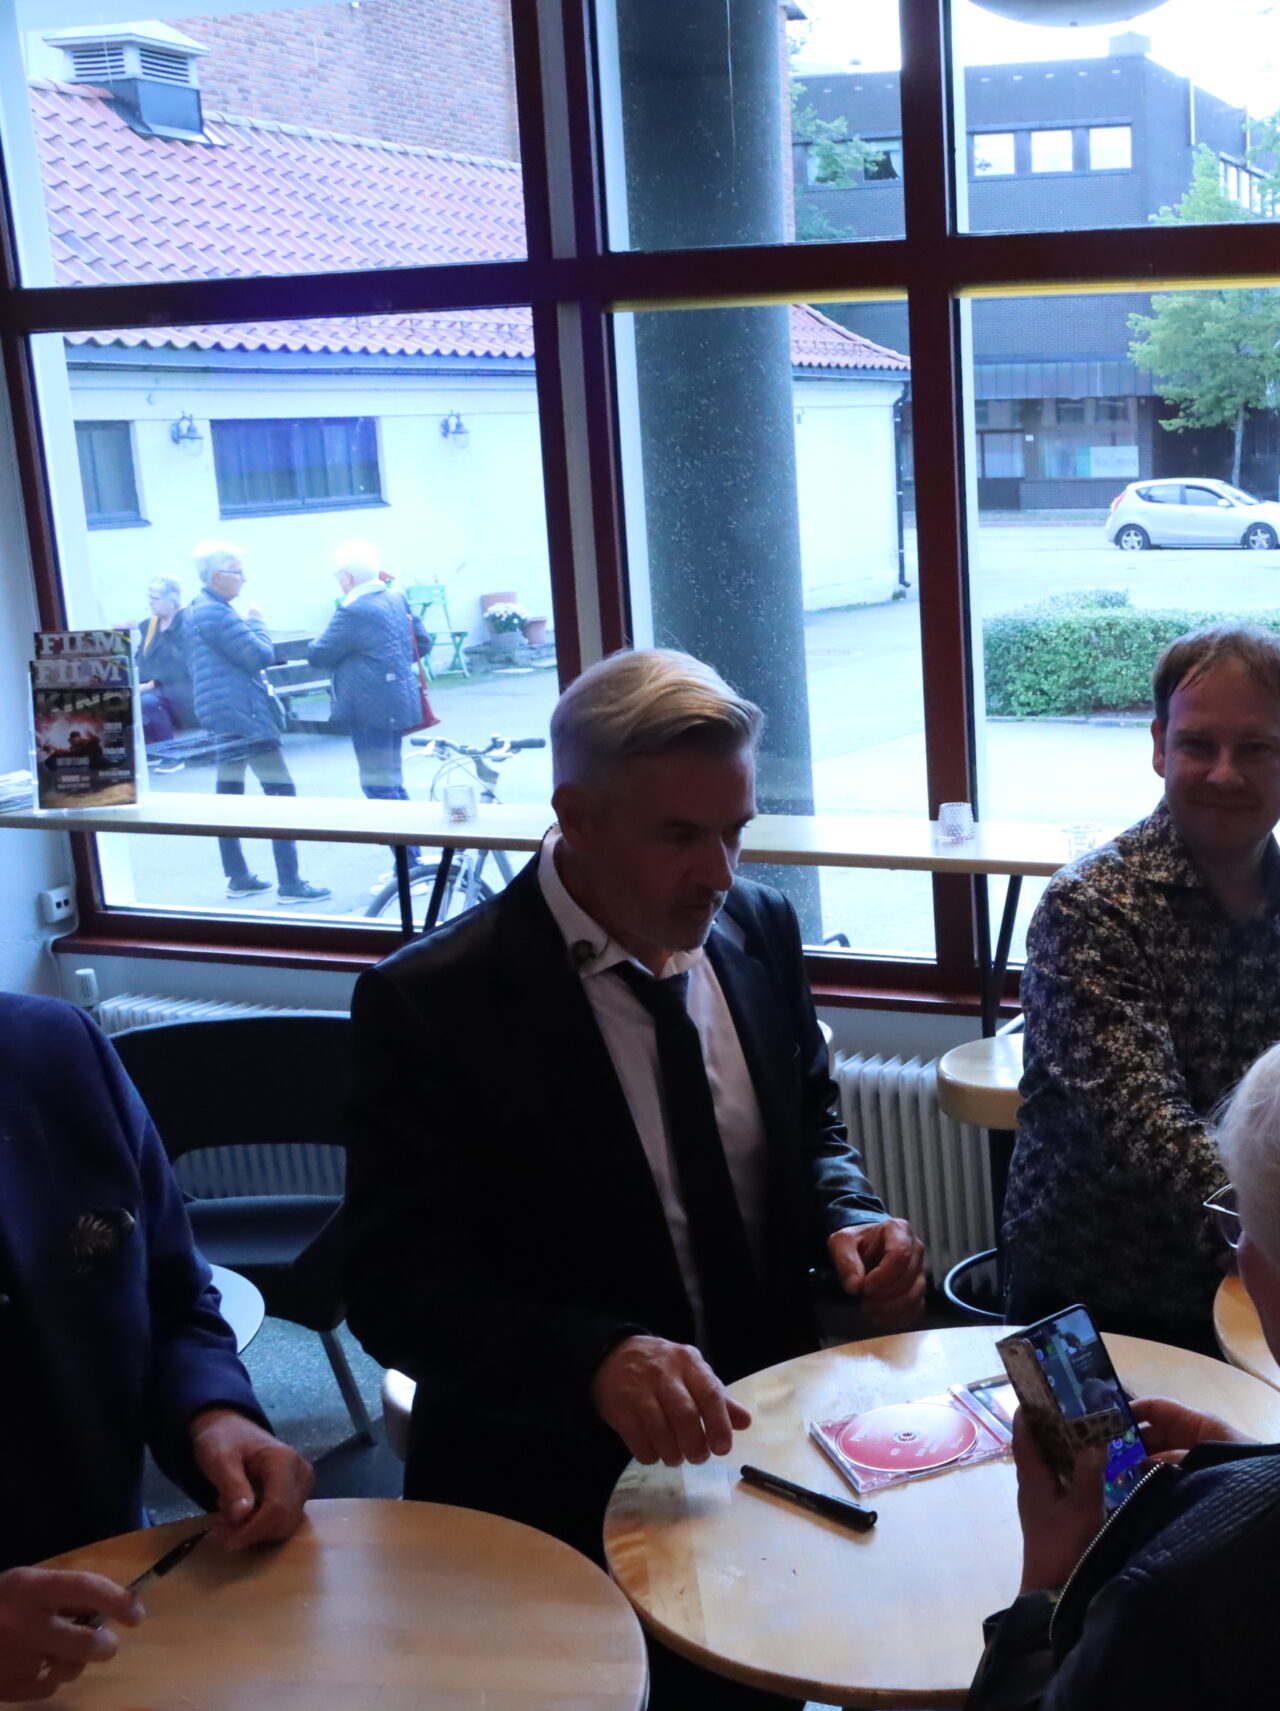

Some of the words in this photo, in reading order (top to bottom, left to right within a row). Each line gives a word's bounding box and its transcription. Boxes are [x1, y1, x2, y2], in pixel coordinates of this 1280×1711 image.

[40, 632, 126, 655] FILM
[36, 661, 121, 684] FILM
[37, 691, 129, 713] KINO
